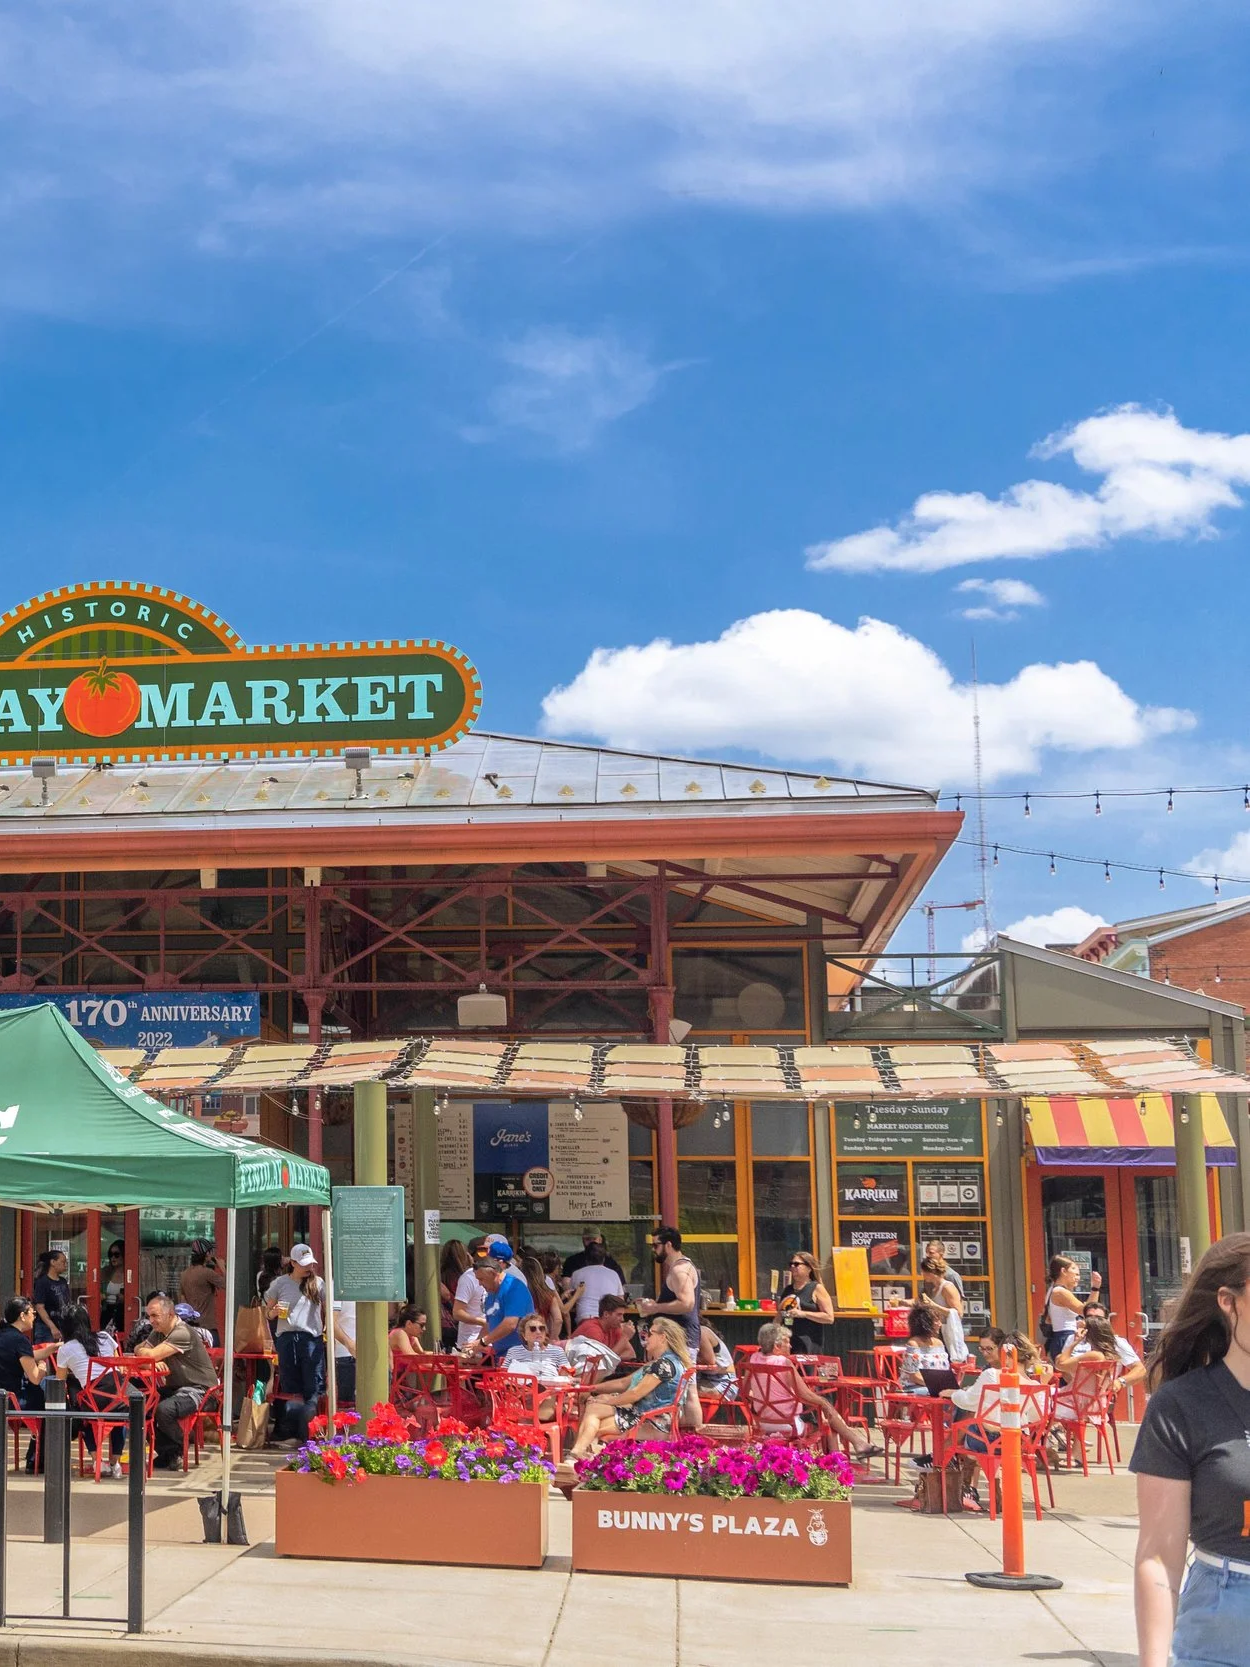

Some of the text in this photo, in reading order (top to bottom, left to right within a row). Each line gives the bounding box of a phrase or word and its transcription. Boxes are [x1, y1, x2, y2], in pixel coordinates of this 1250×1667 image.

[16, 602, 193, 643] HISTORIC
[134, 674, 443, 729] MARKET
[65, 999, 252, 1027] 170th ANNIVERSARY
[138, 1032, 173, 1047] 2022
[490, 1128, 532, 1146] Jane's
[240, 1160, 330, 1193] FINDLAY MARKET
[844, 1188, 898, 1202] KARRIKIN
[851, 1231, 897, 1240] NORTHERN
[851, 1238, 872, 1246] ROW
[597, 1509, 800, 1537] BUNNY'S PLAZA
